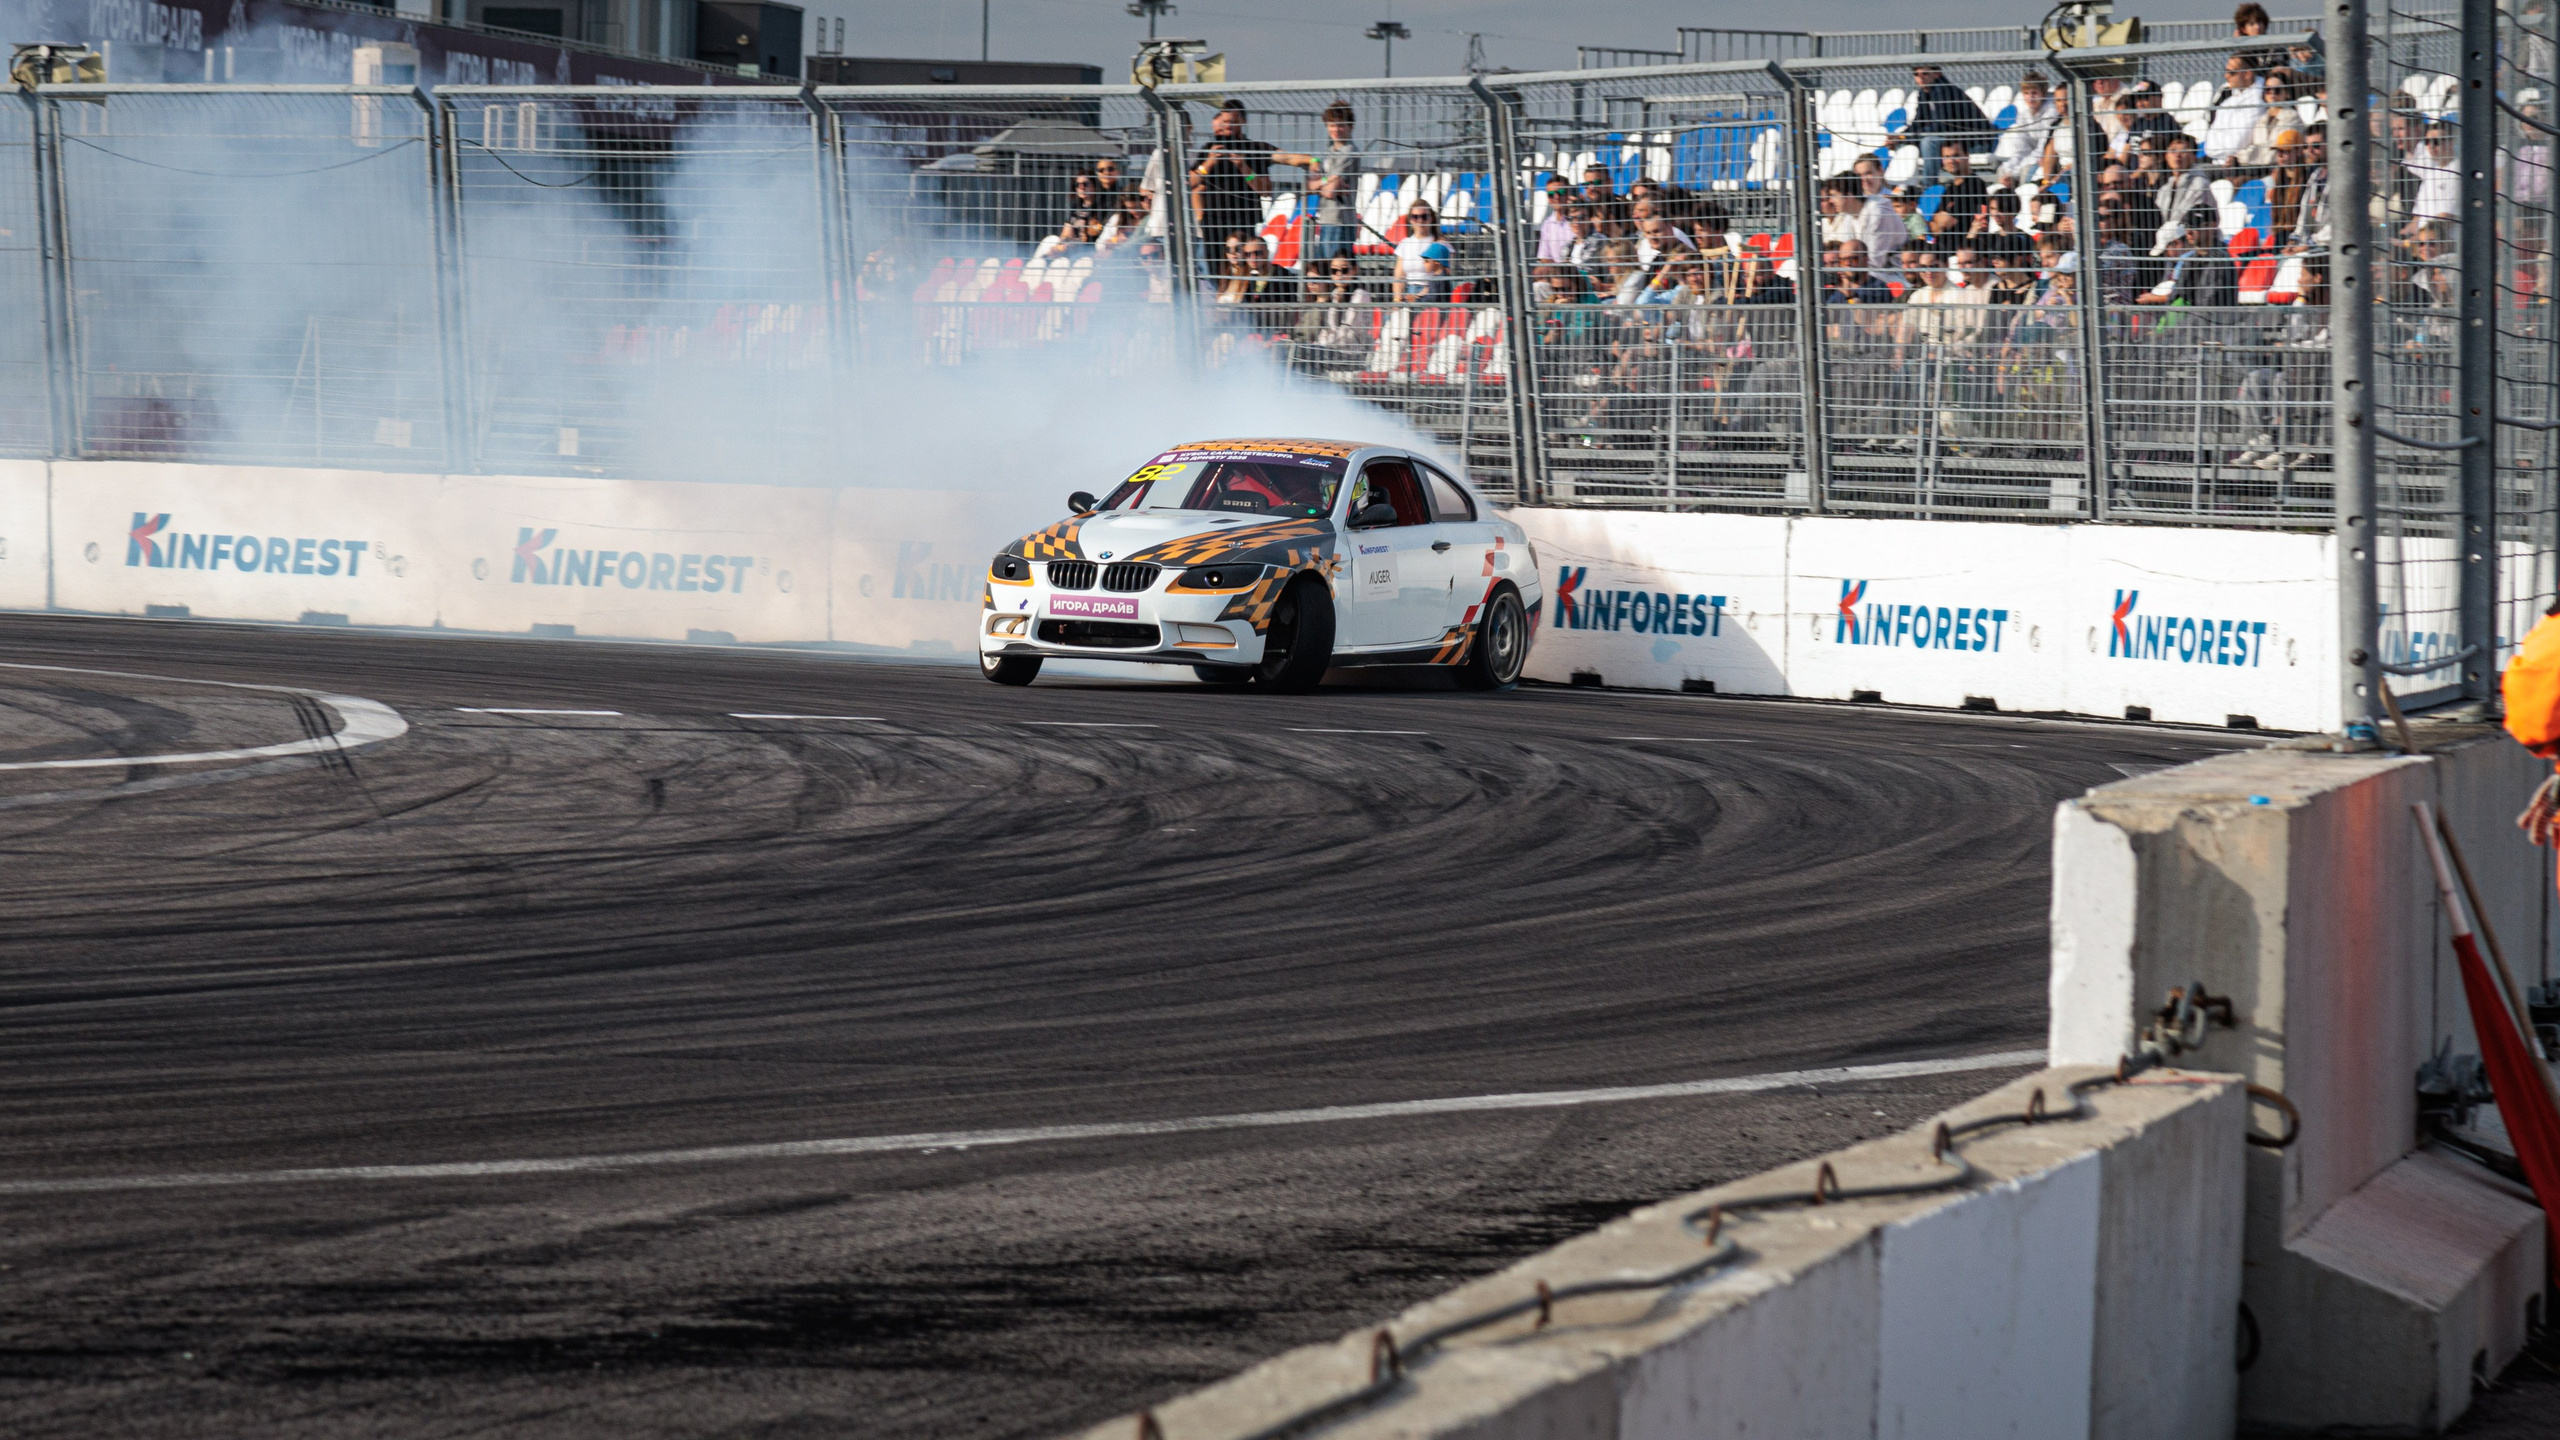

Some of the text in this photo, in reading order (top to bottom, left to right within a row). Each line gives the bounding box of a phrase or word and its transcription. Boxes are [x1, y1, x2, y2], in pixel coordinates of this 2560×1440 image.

[1129, 464, 1187, 482] 82
[1209, 450, 1293, 459] САНКТ-ПЕТЕРБУРГА
[125, 512, 368, 577] KINFOREST
[510, 527, 753, 593] KINFOREST
[892, 541, 985, 602] KINF
[1358, 544, 1389, 555] KINFOREST
[1053, 600, 1134, 614] ИГОРА ДРАЙВ
[1369, 570, 1391, 585] AUGER
[1553, 565, 1726, 637] KINFOREST
[1836, 579, 2008, 652] KINFOREST
[2109, 589, 2266, 667] KINFOREST
